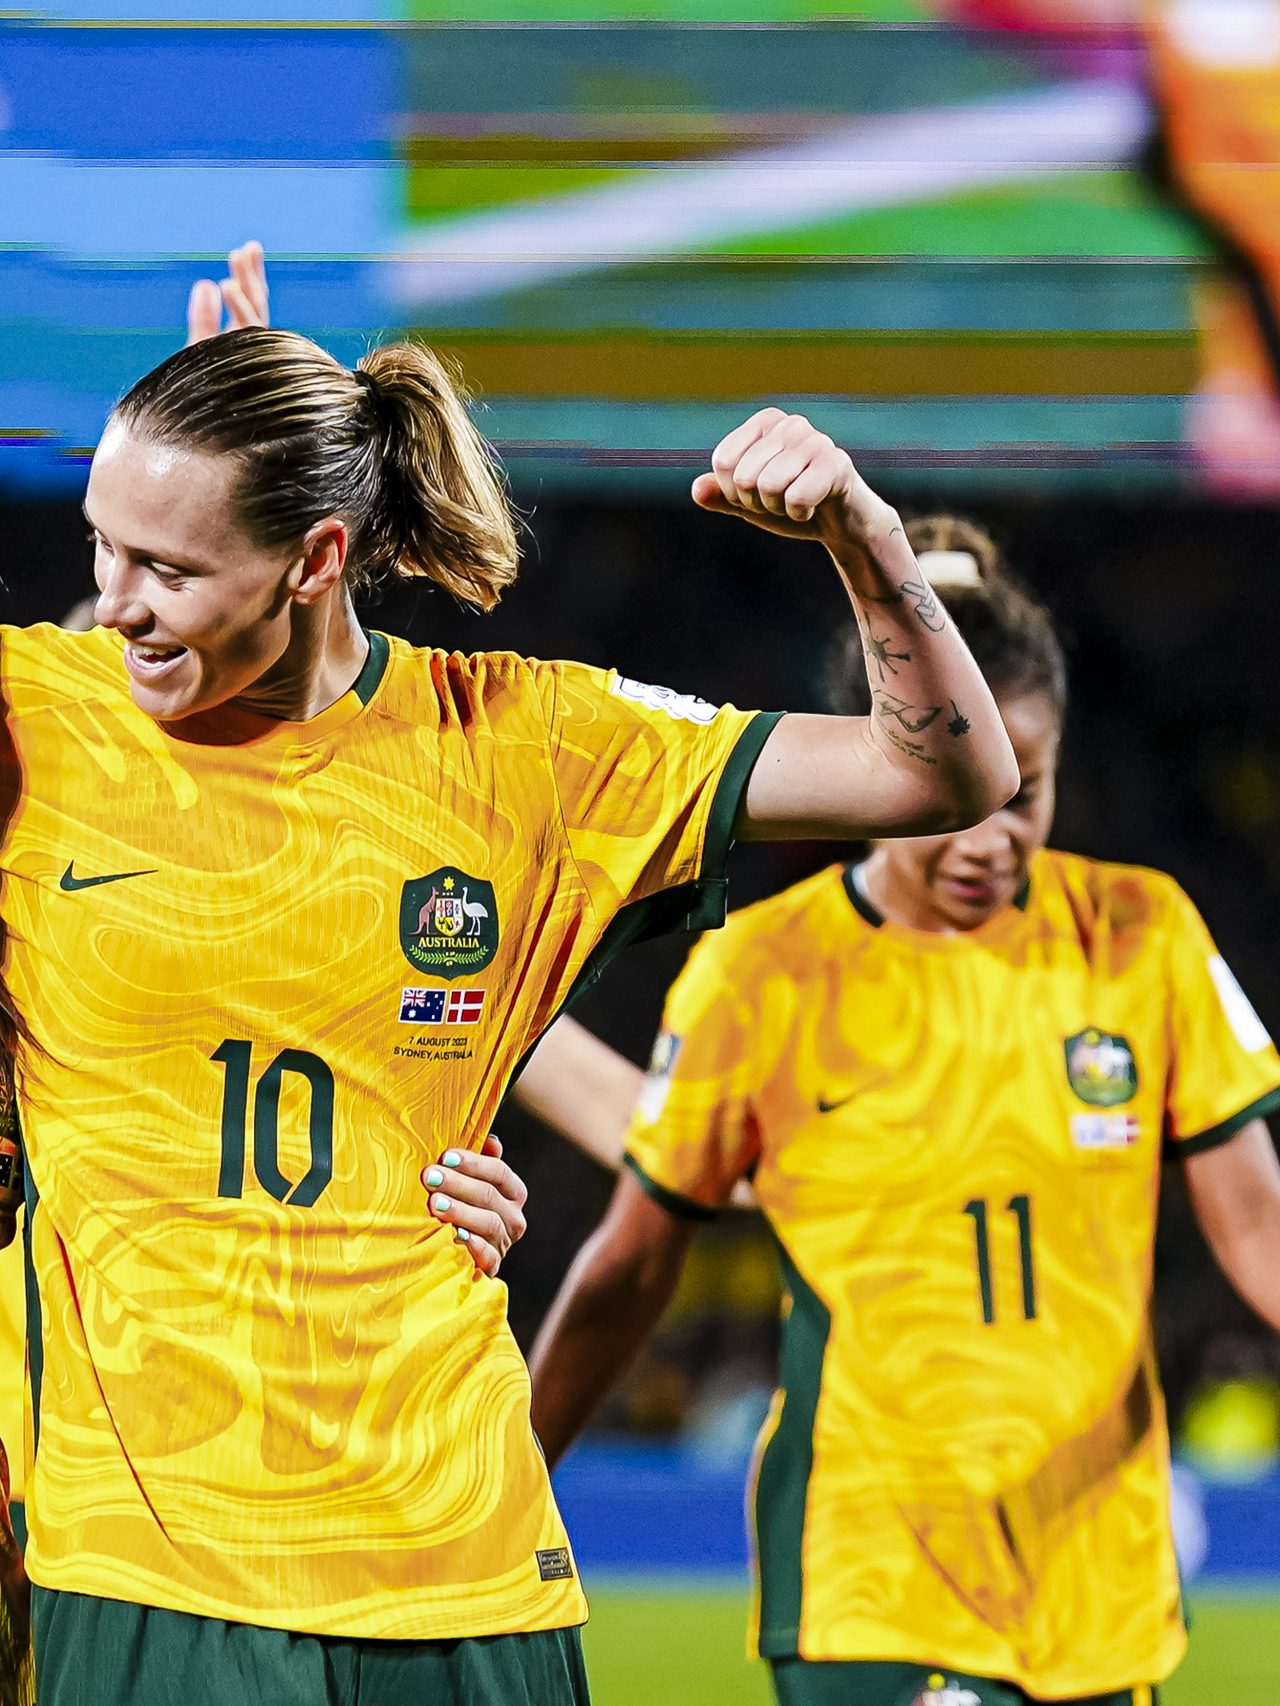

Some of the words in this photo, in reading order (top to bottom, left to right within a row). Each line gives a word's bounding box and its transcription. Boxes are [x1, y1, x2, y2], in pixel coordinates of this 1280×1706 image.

[418, 936, 480, 948] AUSTRALIA
[409, 1036, 414, 1045] 7
[416, 1037, 449, 1047] AUGUST
[209, 1038, 335, 1208] 10
[963, 1195, 1036, 1323] 11
